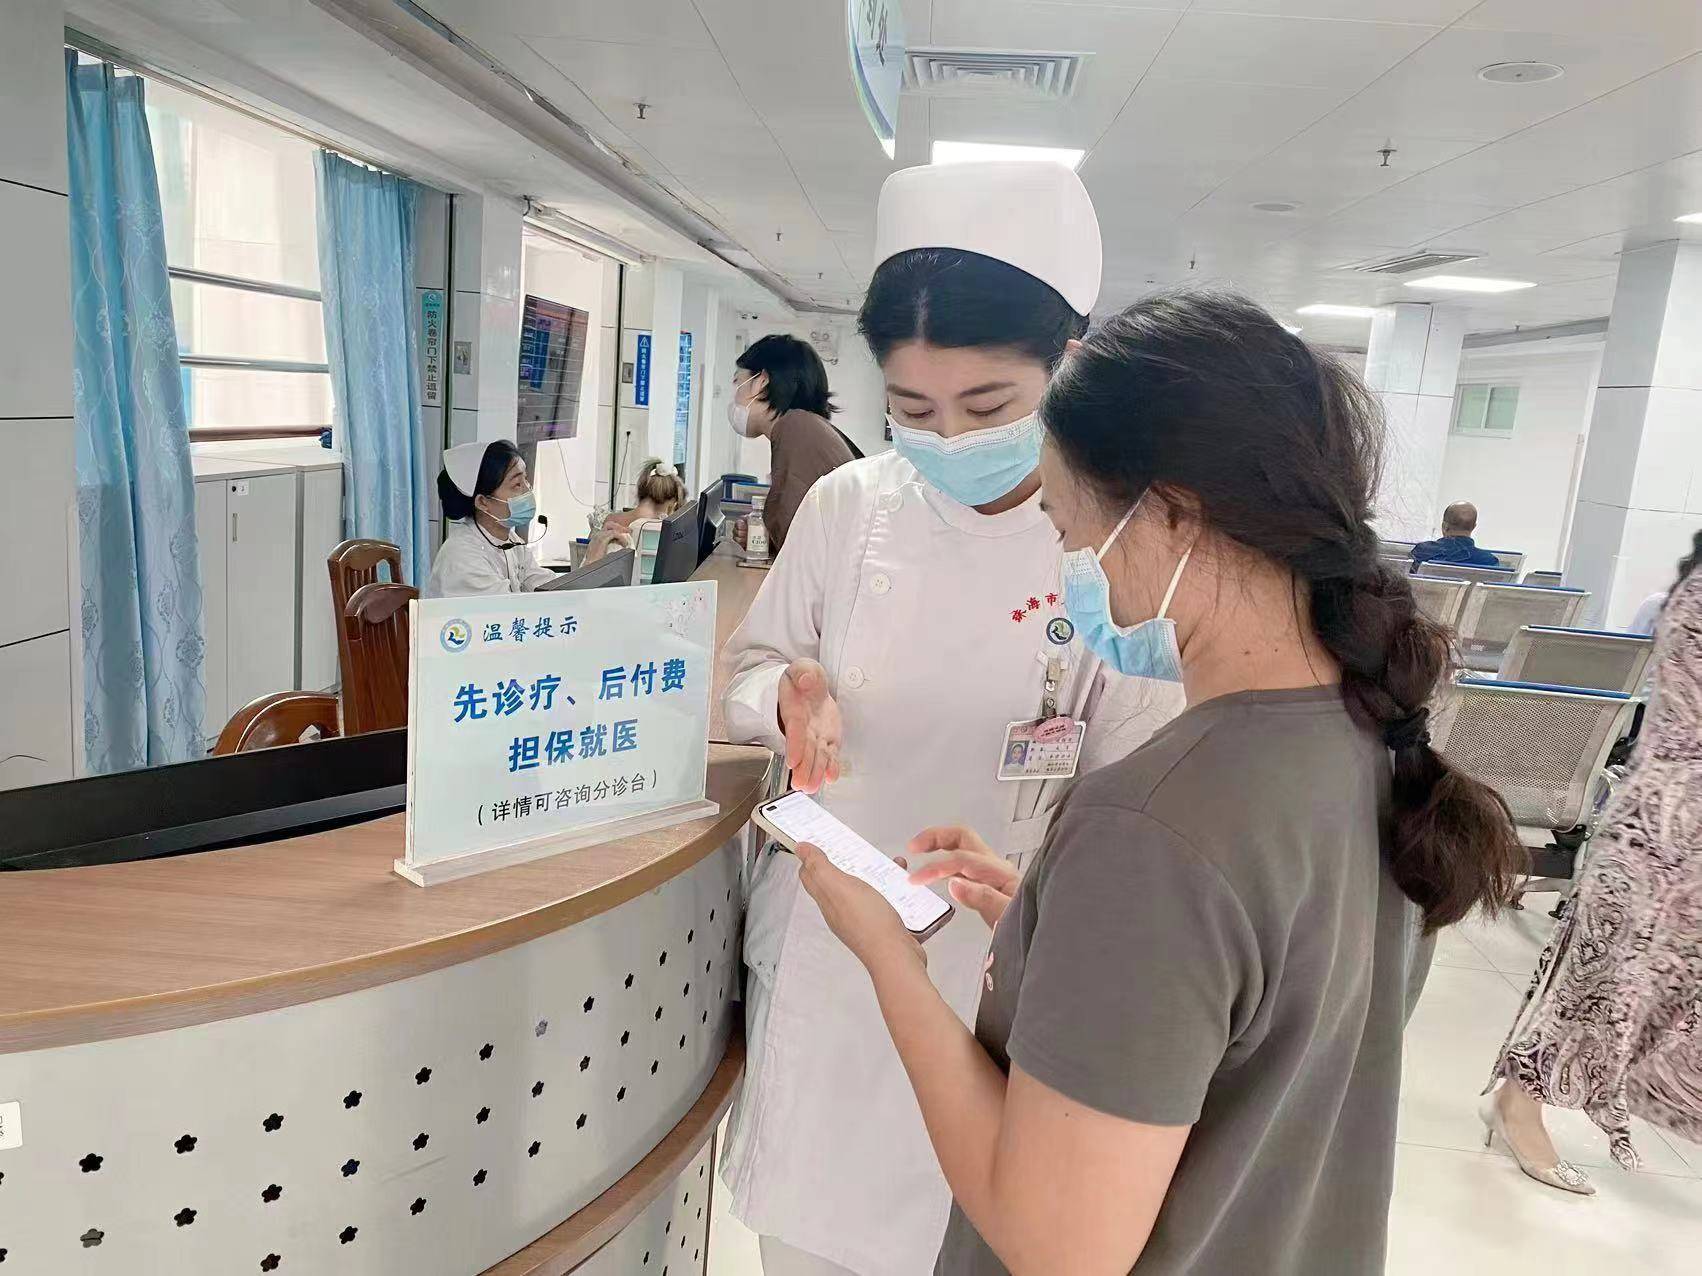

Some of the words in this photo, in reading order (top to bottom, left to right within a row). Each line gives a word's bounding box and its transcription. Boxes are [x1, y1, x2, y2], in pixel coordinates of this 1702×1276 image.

[483, 616, 578, 642] 温馨提示
[508, 718, 639, 773] 担保就医
